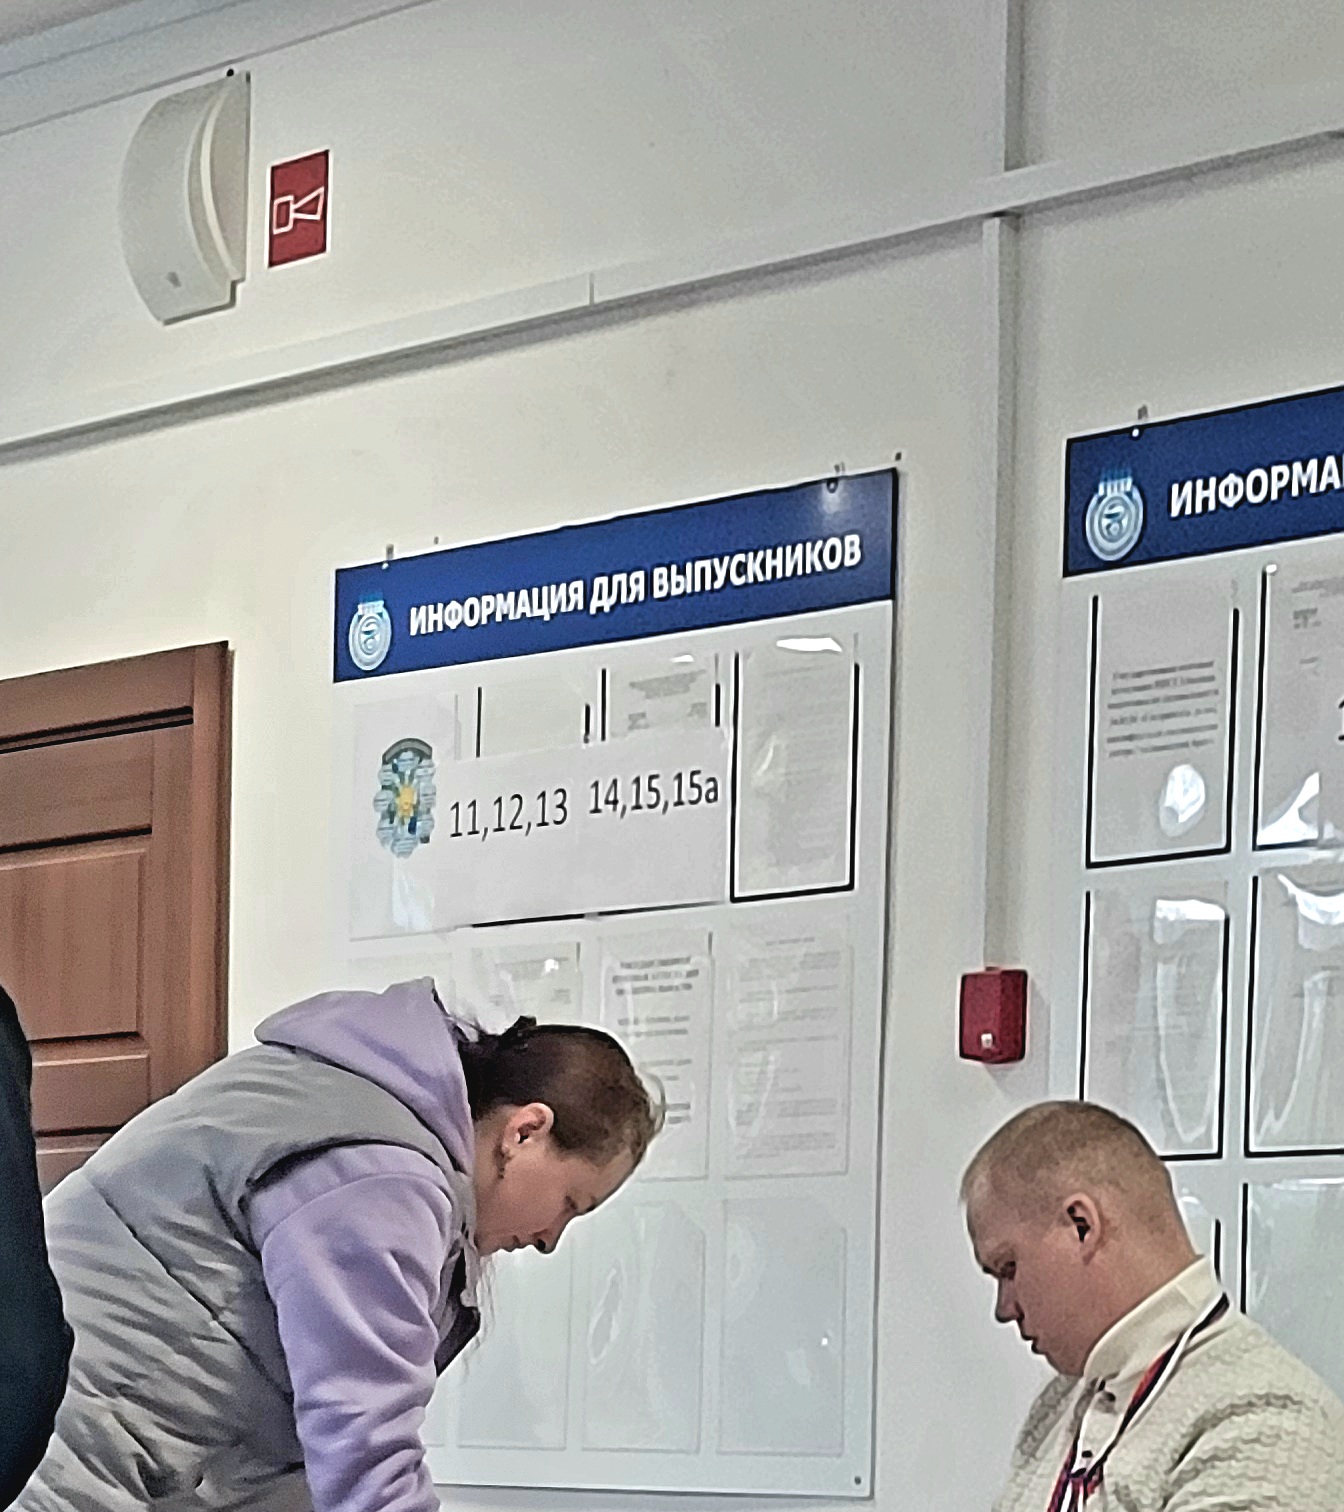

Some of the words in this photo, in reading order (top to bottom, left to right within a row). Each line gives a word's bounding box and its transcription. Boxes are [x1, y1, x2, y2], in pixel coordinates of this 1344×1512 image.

[1169, 455, 1344, 518] ИНФОРМА
[409, 580, 585, 636] ИНФОРМАЦИЯ
[588, 571, 645, 615] ДЛЯ
[652, 533, 863, 599] ВЫПУСКНИКОВ
[449, 787, 569, 843] 11,12,13
